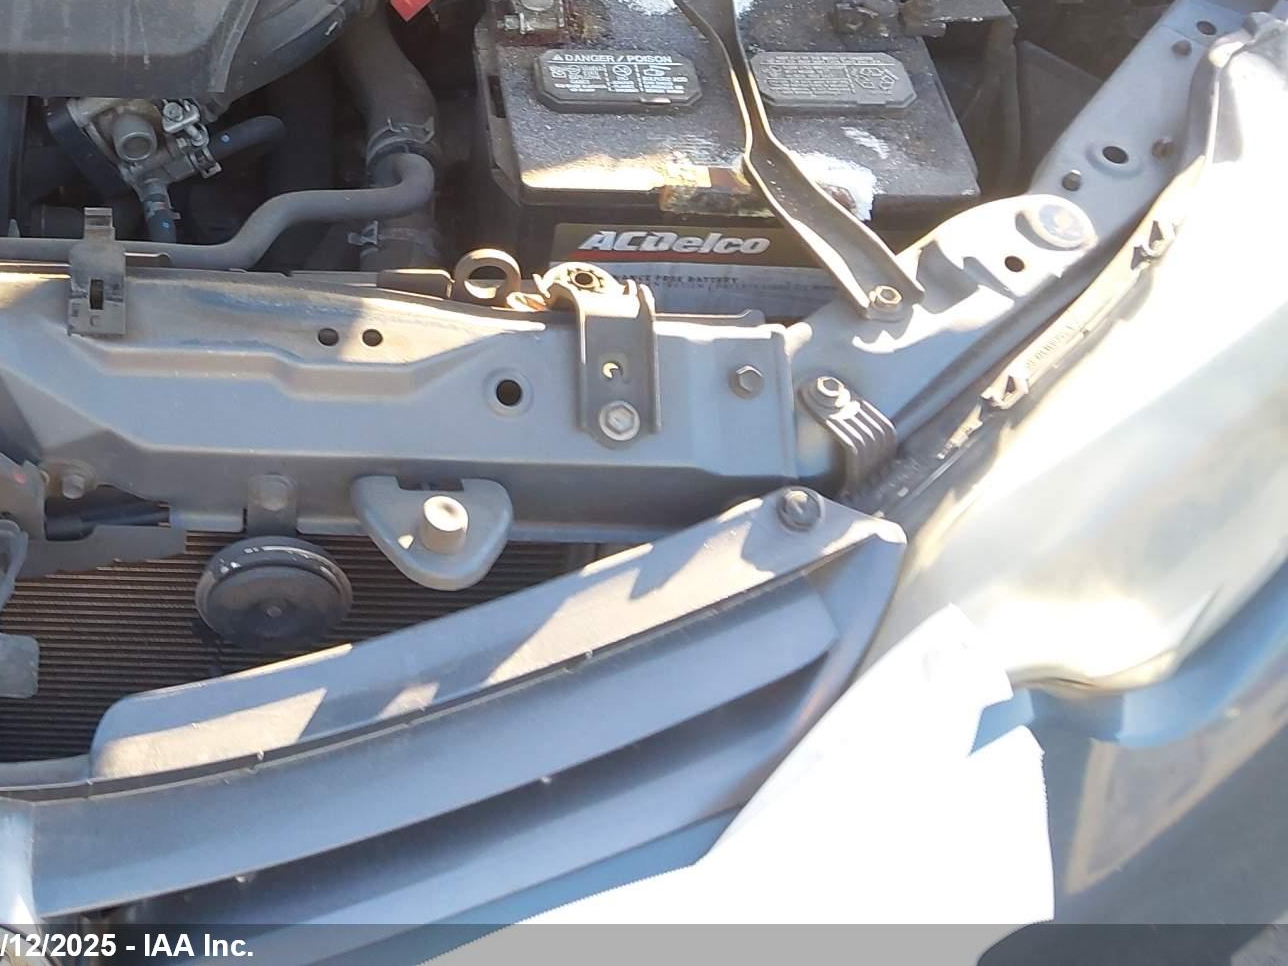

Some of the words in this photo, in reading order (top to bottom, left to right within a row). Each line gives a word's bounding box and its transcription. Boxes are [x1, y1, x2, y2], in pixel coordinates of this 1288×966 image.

[565, 54, 615, 63] DANGER
[627, 55, 673, 63] POISON
[578, 230, 771, 255] ACDelco
